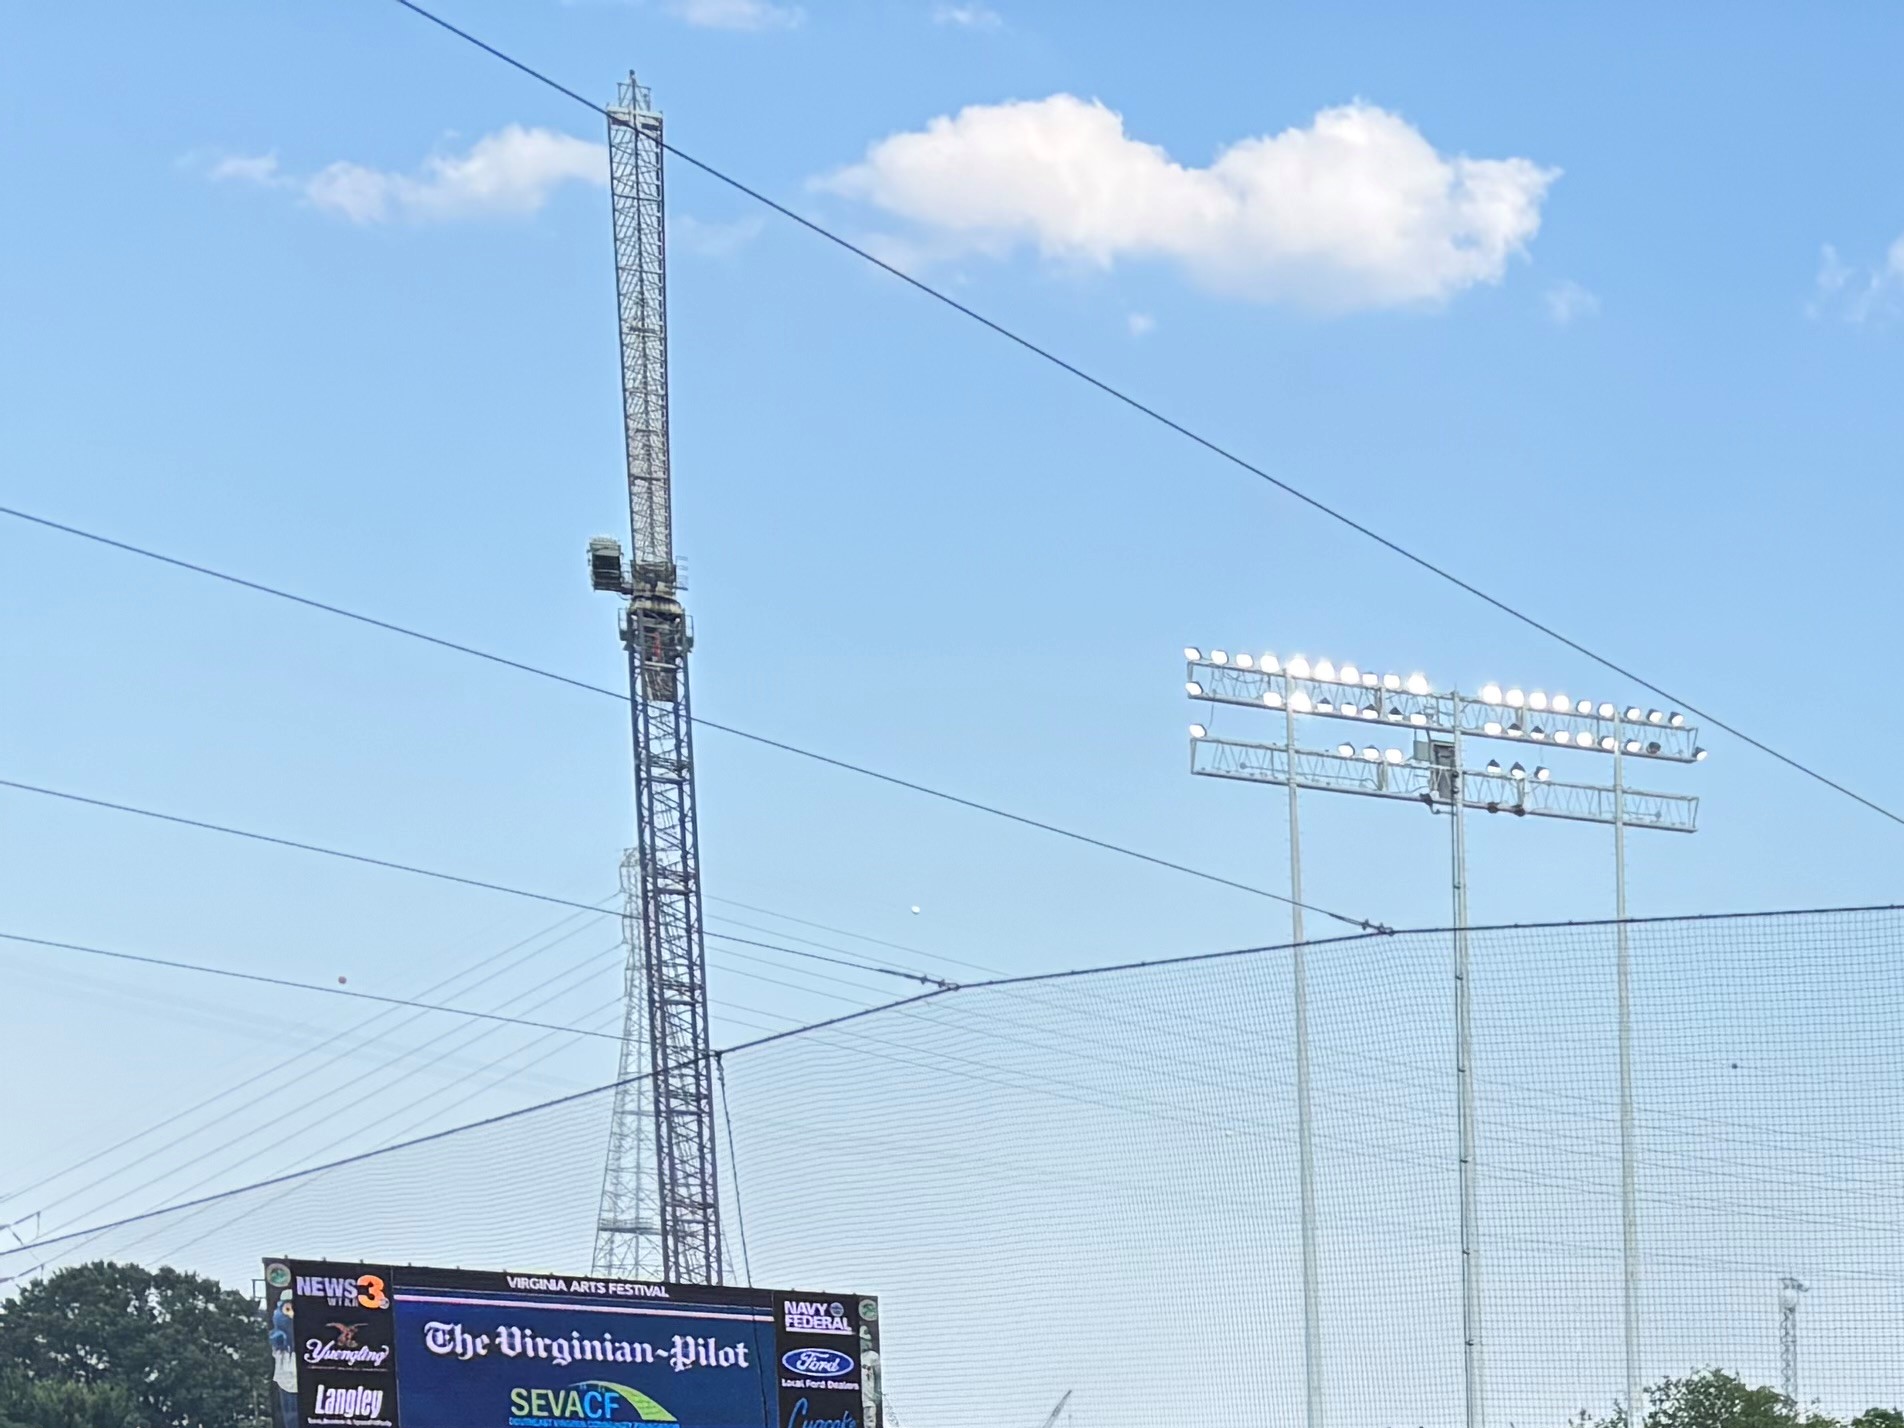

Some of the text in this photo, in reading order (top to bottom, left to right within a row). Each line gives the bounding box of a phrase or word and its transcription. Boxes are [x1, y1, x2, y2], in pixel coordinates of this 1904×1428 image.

[297, 1275, 385, 1309] NEWS 3
[507, 1276, 669, 1298] VIRGINIA ARTS FESTIVAL
[785, 1301, 827, 1316] NAVY
[785, 1315, 852, 1331] FEDERAL
[304, 1339, 389, 1366] Yuengling
[424, 1321, 490, 1360] The
[797, 1352, 838, 1371] Ford
[314, 1384, 383, 1418] Langley
[510, 1387, 621, 1418] SEVACF
